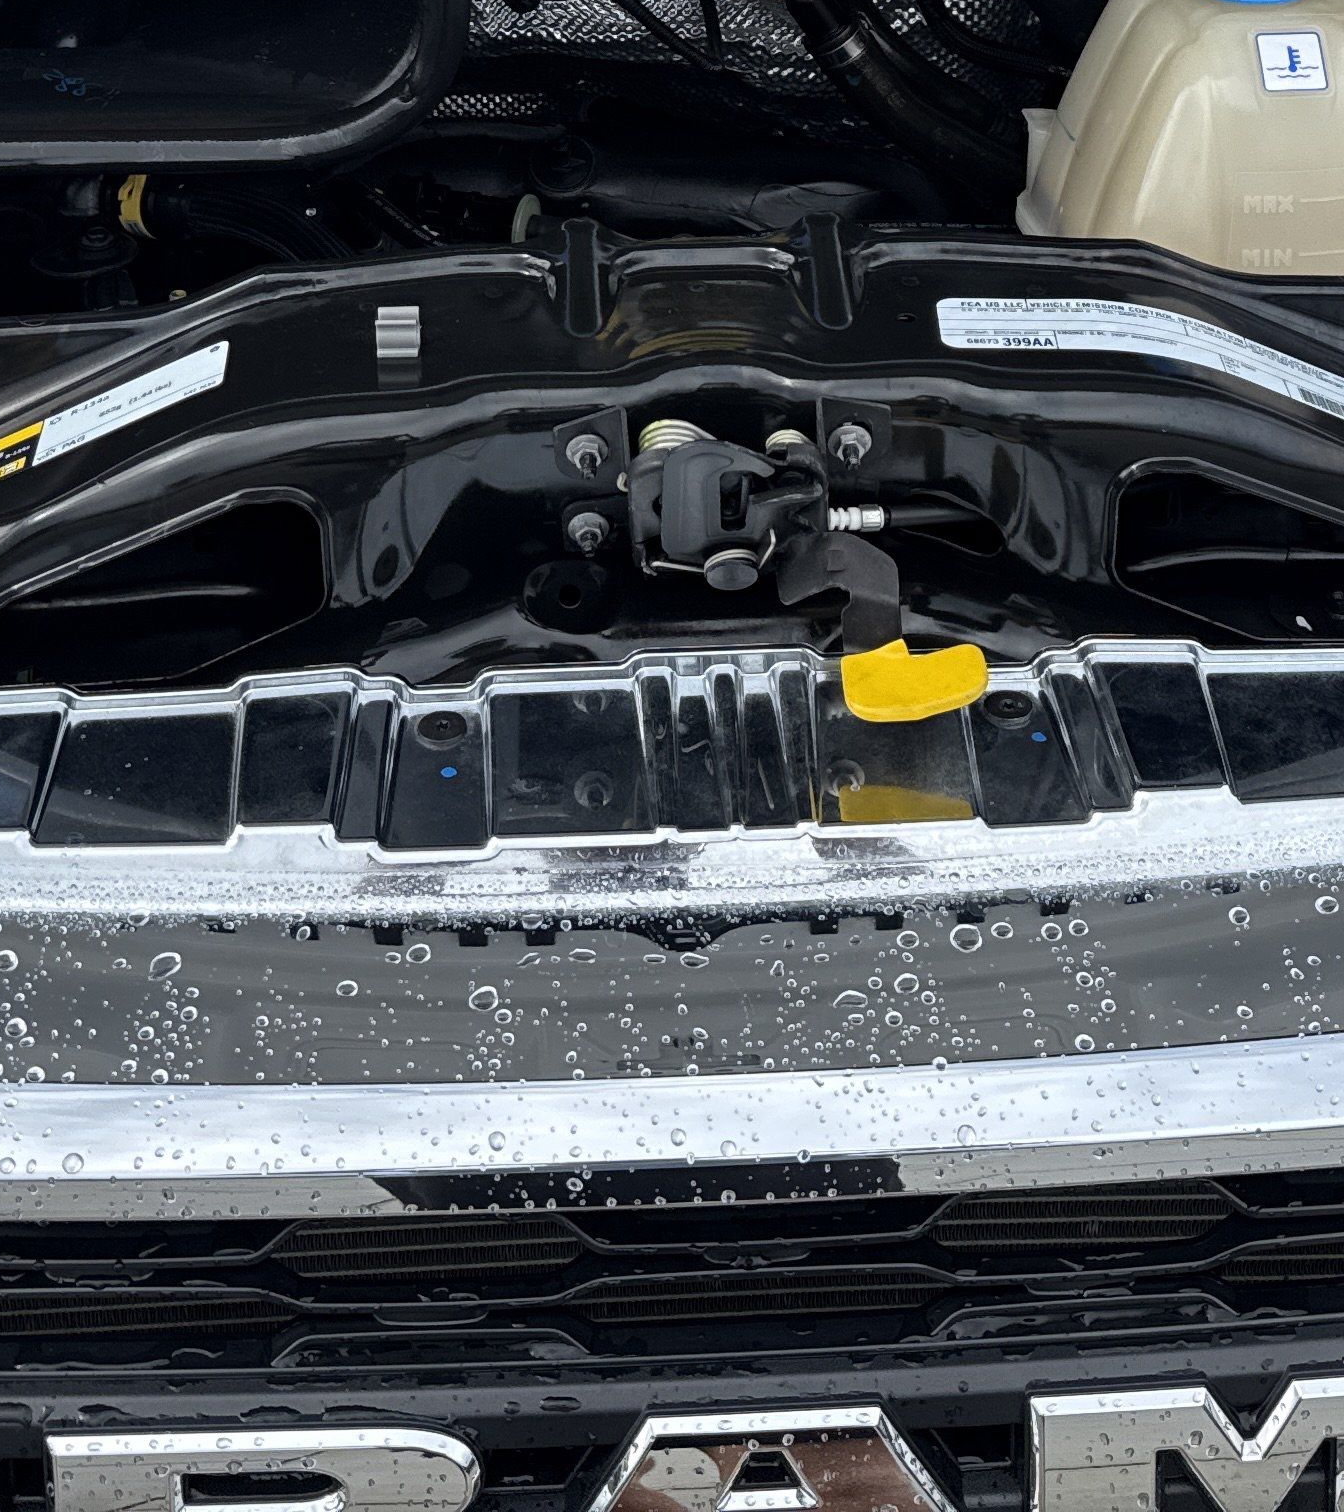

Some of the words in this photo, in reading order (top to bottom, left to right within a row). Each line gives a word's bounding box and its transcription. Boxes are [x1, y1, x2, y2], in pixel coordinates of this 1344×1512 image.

[1242, 194, 1295, 215] MAX
[1240, 247, 1294, 269] MIN
[1002, 337, 1055, 347] 399AA
[61, 434, 86, 451] PAG
